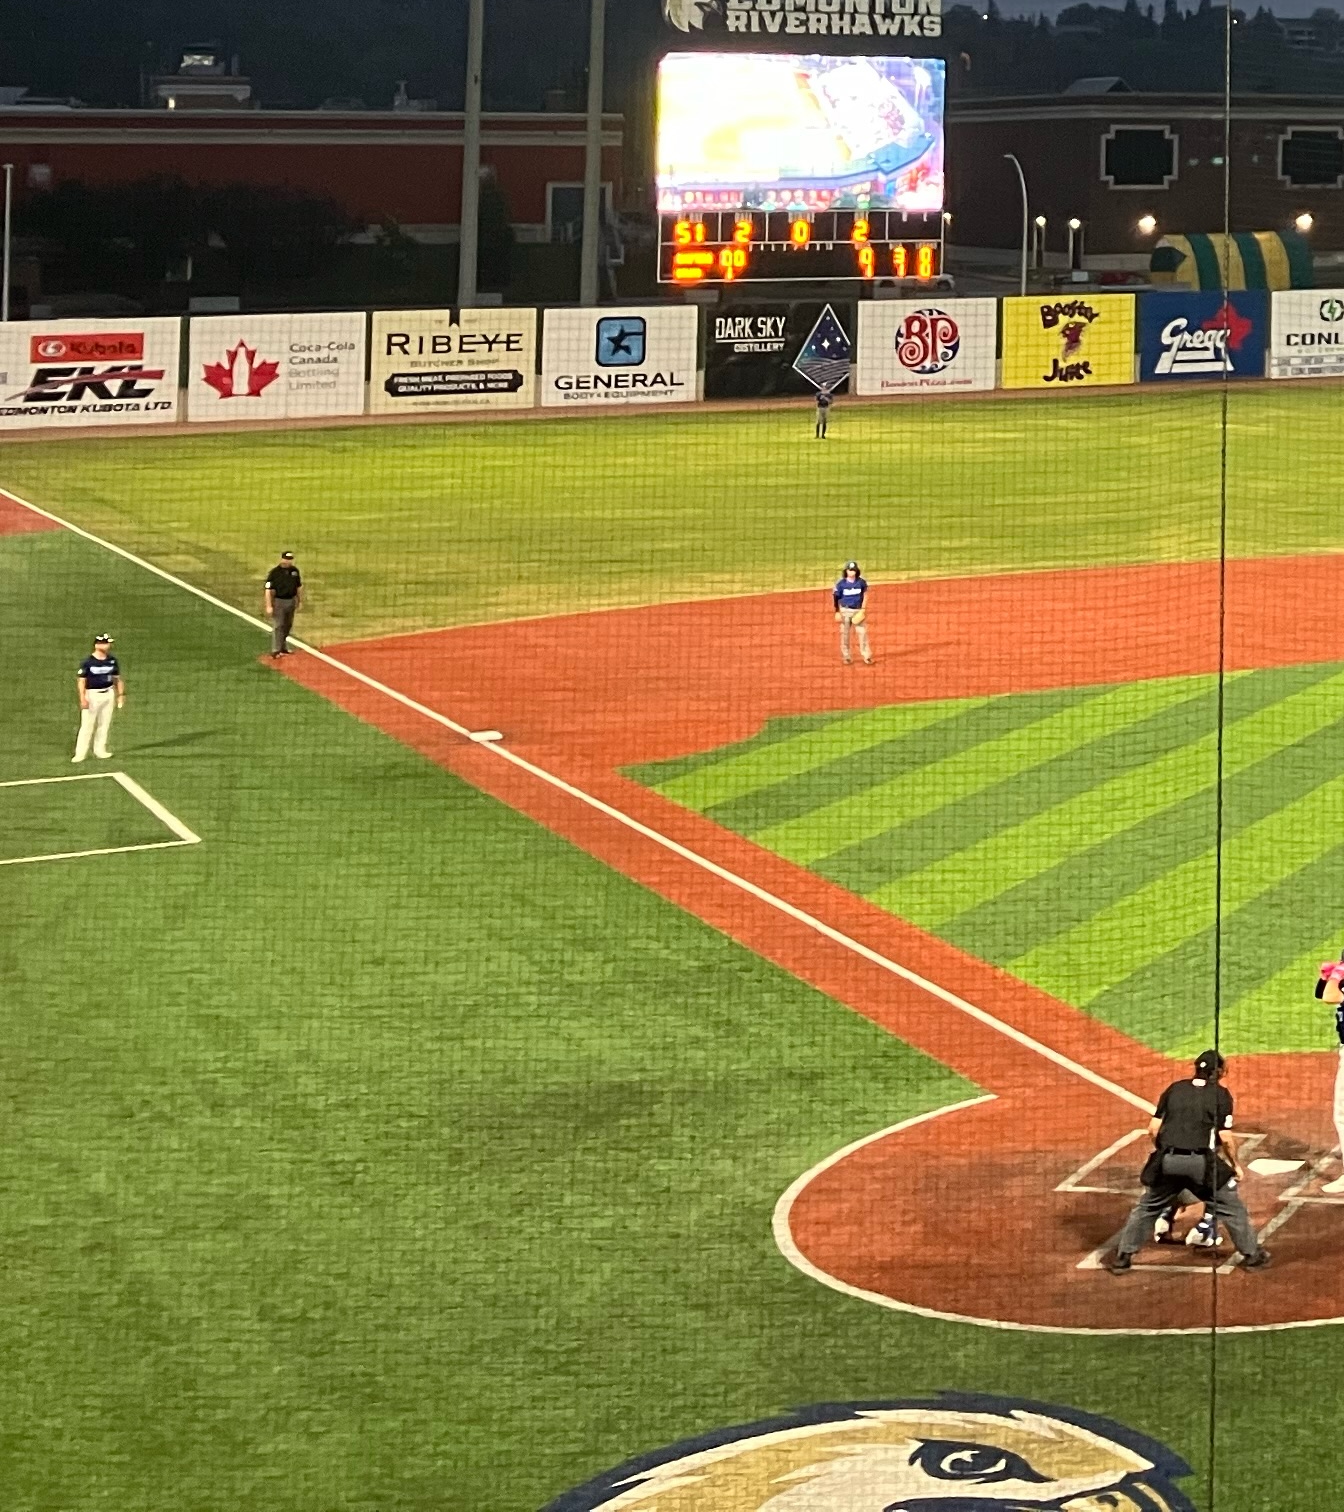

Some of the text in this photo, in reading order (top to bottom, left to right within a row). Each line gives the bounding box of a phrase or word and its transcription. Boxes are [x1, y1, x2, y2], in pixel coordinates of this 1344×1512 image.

[726, 11, 943, 37] RIVERHAWKS
[715, 317, 786, 338] DARK SKY
[69, 341, 137, 355] Kubota
[289, 341, 355, 353] Coca-Cola
[386, 333, 523, 355] RIBEYE
[289, 354, 338, 365] Canada
[410, 360, 463, 368] BUTCHER
[23, 365, 155, 402] EKL
[554, 372, 684, 390] GENERAL
[0, 405, 78, 416] EDMONTON
[80, 402, 141, 413] KUBOTA
